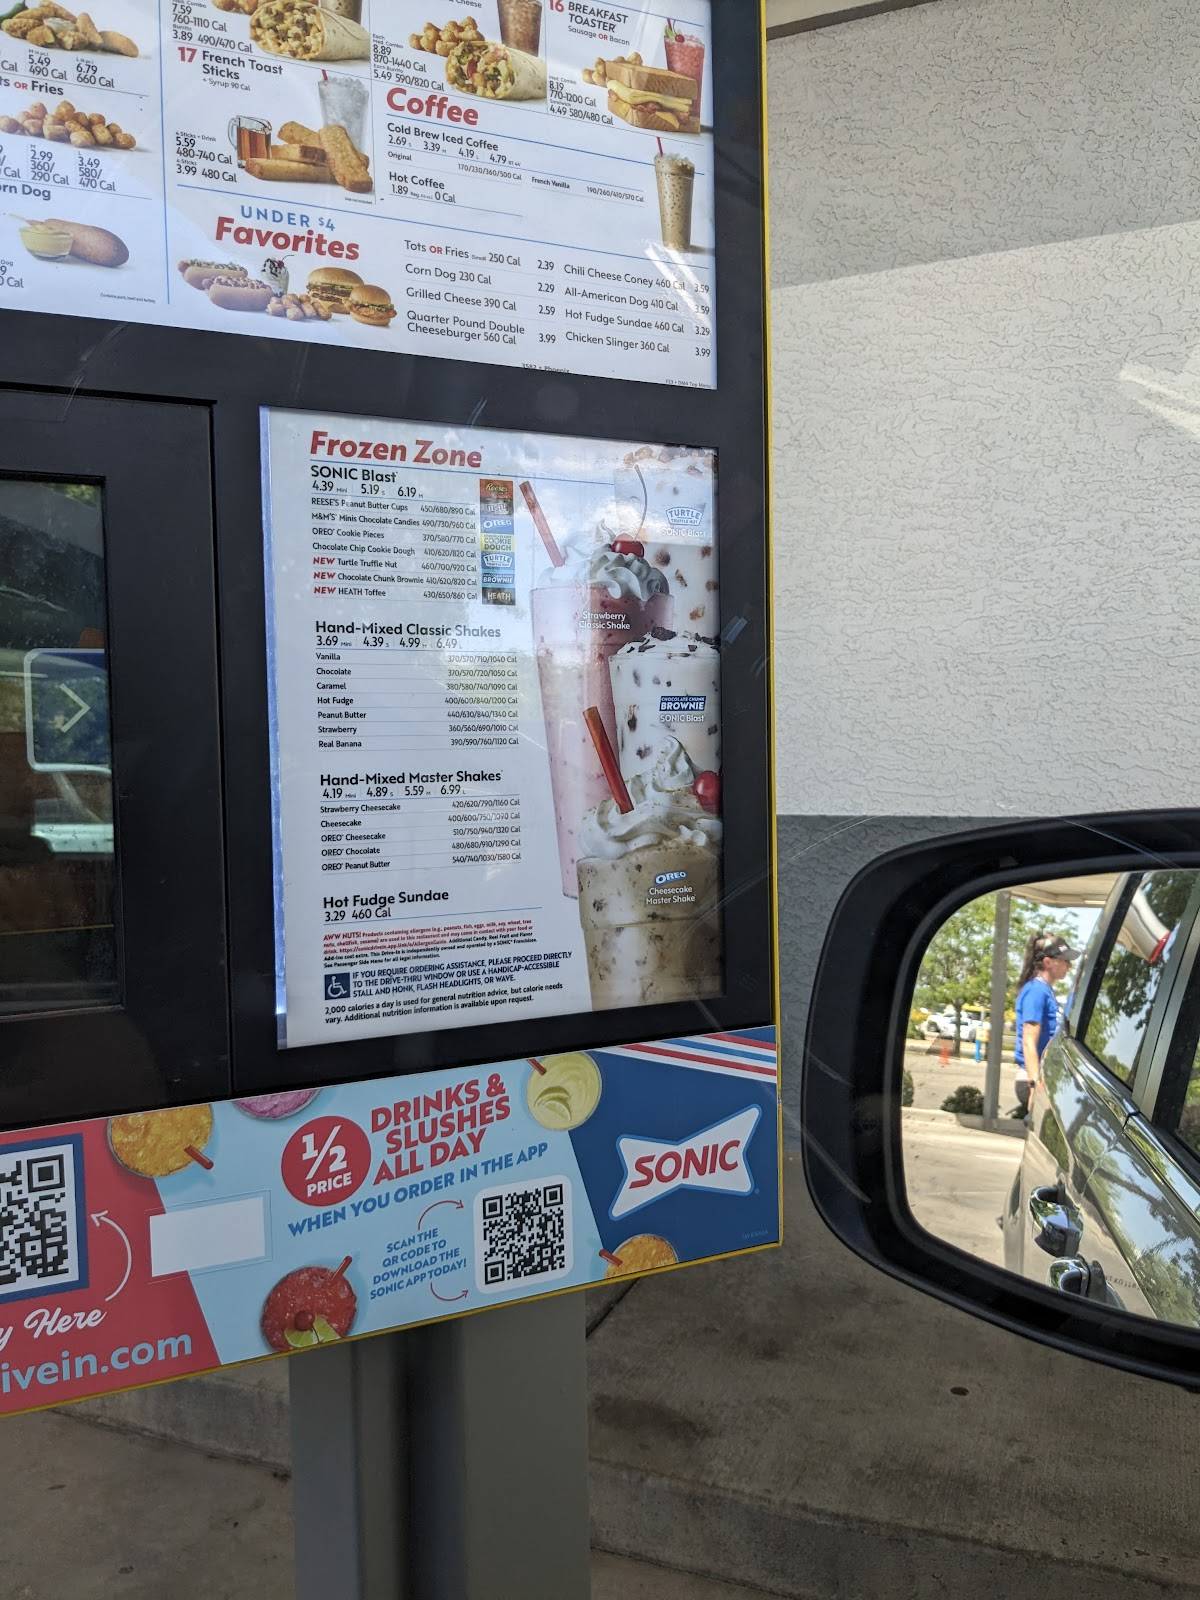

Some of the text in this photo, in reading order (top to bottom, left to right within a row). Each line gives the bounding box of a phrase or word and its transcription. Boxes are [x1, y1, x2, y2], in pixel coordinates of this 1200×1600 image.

[568, 2, 628, 24] BREAKFAST
[569, 15, 616, 33] TOASTER
[568, 25, 630, 46] Sausage OR Bacon
[28, 55, 98, 74] 5.49 6.79
[177, 47, 197, 62] 17
[202, 50, 283, 75] French Toast
[202, 64, 240, 80] Sticks
[14, 80, 64, 96] OR Fries
[386, 87, 479, 126] Coffee
[388, 123, 499, 151] Cold Brew Iced Coffee
[388, 134, 407, 146] 2.69
[423, 141, 441, 152] 3.39
[458, 147, 475, 159] 4.19
[489, 153, 507, 165] 4.79
[389, 172, 445, 190] Hot Coffee
[392, 185, 408, 196] 1.89
[22, 184, 51, 200] Dog
[240, 205, 336, 230] UNDER $4
[216, 216, 360, 260] Favorites
[404, 240, 554, 271] Tots OR Fries 250 Cal 2.39
[405, 264, 555, 294] Corn Dog 230 Cal 2.29
[564, 264, 671, 289] Chili Cheese Coney 460
[406, 287, 556, 316] Grilled Cheese 390 Cal 2.59
[565, 287, 679, 311] All-American Dog 410 Cal
[407, 310, 525, 335] Quarter Pound Double
[565, 309, 710, 336] Hot Fudge Sundae 460 Cal 3.29
[407, 322, 556, 345] Cheeseburger 560 Cal 3.99
[565, 332, 711, 357] Chicken Slinger 360 Cal 3.99
[310, 431, 482, 467] Frozen Zone
[311, 465, 398, 483] SONIC Blast
[312, 481, 416, 498] 4.39 5.19 6.19
[313, 557, 398, 569] NEW Turtle Truffle Nut
[316, 621, 501, 637] Hand-Mixed Classic Shakes
[317, 636, 457, 648] 3.69 4.39 4.99 6.49
[316, 653, 341, 661] Vanilla
[317, 682, 347, 690] Caramel
[332, 697, 354, 705] Fudge
[661, 701, 704, 710] BROWNIE
[344, 711, 366, 719] Butter
[318, 726, 357, 735] Strawberry
[318, 740, 334, 748] Real
[320, 771, 501, 786] Hand-Mixed Master Shakes
[322, 785, 461, 799] 4.19 4.89 5.59 6.99
[656, 871, 687, 883] OREO
[323, 890, 449, 909] Hot Fudge Sundae
[646, 895, 695, 904] Master Shake
[649, 886, 693, 895] Cheesecake
[325, 907, 391, 922] 3.29 460 Cal
[353, 989, 373, 997] STALL
[375, 987, 391, 995] AND
[416, 982, 438, 991] FLASH
[484, 976, 492, 984] OR
[371, 1073, 506, 1133] DRINKS &
[387, 1096, 510, 1154] SLUSHES
[373, 1128, 486, 1186] ALL DAY
[629, 1140, 740, 1189] SONIC
[288, 1142, 548, 1237] WHEN YOU ORDER IN THE APP
[307, 1172, 352, 1197] PRICE
[387, 1228, 439, 1252] SCAN THE
[383, 1240, 446, 1268] QR CODE TO
[373, 1248, 460, 1285] DOWNLOAD THE
[370, 1259, 466, 1299] SONIC APP TODAY!
[24, 1307, 107, 1339] Here
